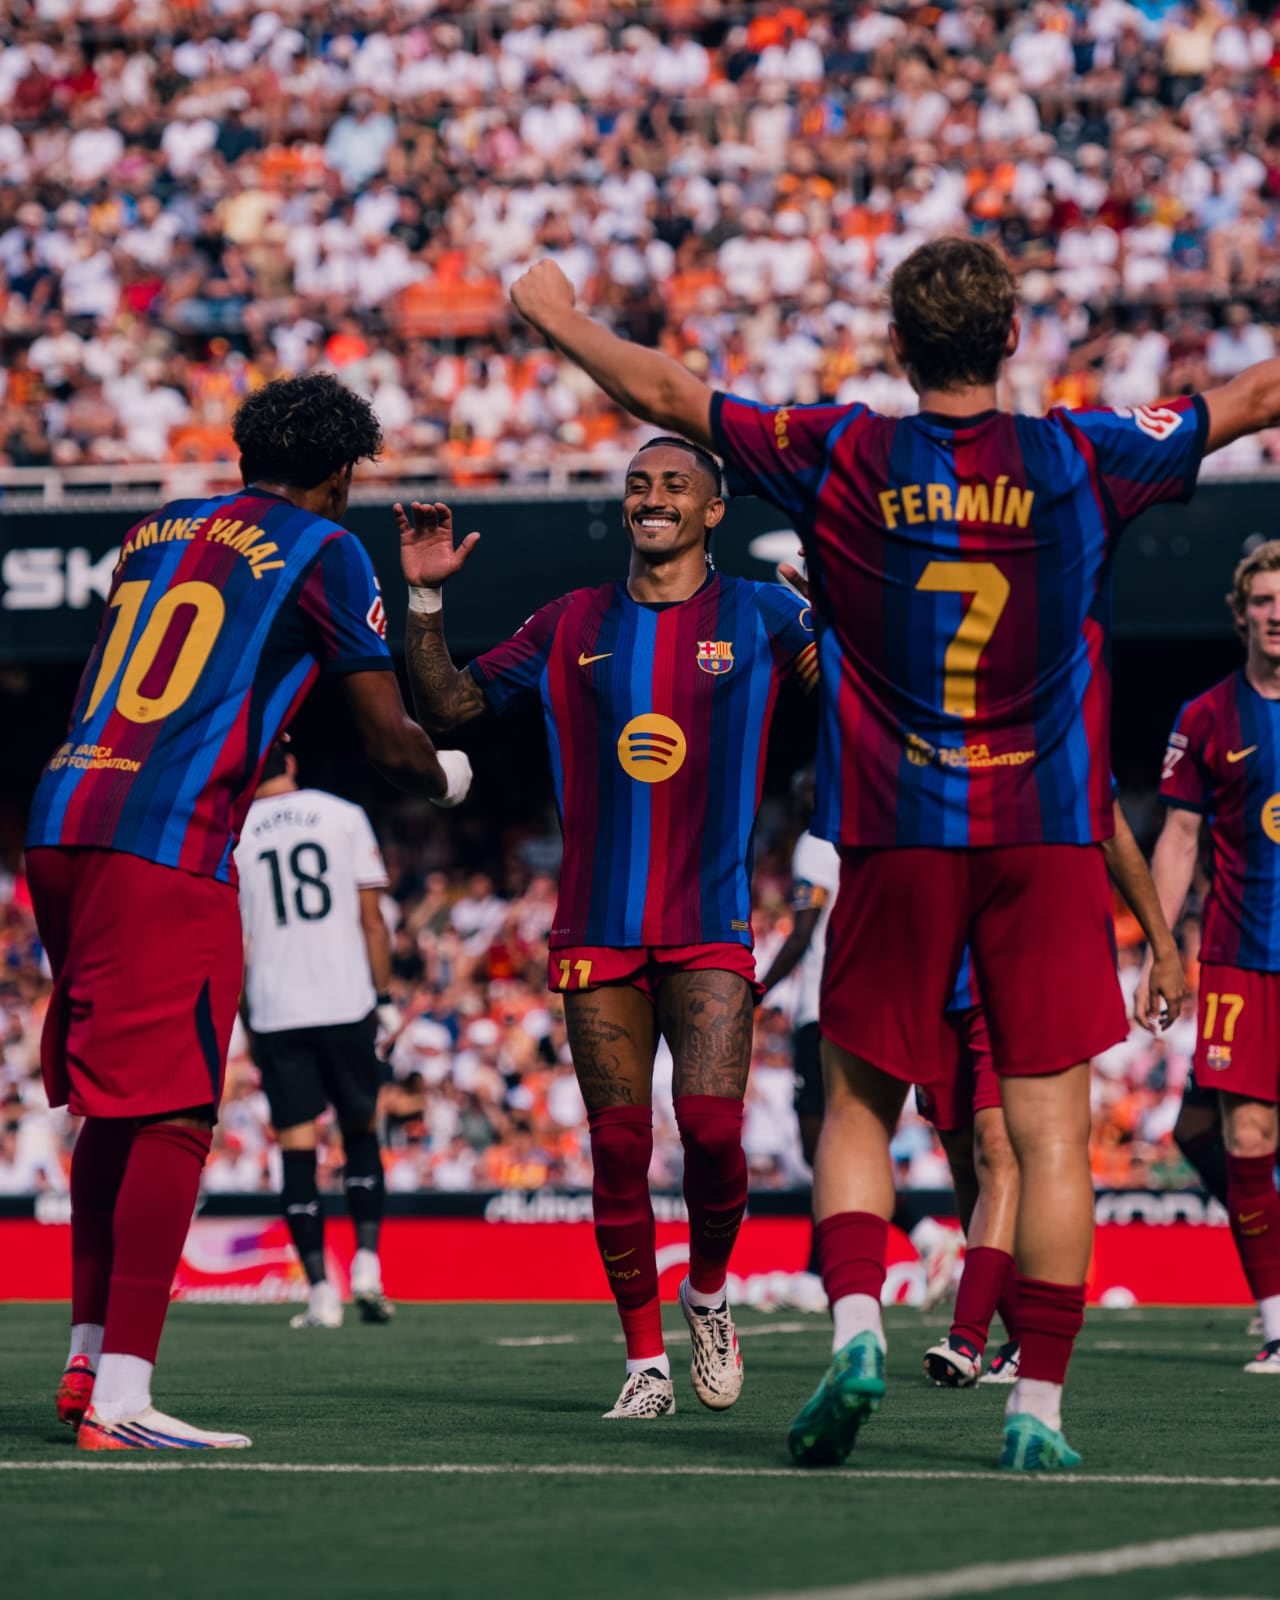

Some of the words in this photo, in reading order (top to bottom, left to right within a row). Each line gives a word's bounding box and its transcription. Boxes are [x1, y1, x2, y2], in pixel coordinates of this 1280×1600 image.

[878, 475, 1035, 530] FERMÍN
[206, 518, 286, 580] YAMAL
[82, 580, 226, 724] 10
[915, 561, 1011, 718] 7
[258, 842, 331, 926] 18
[558, 959, 593, 990] 11
[1203, 992, 1245, 1042] 17
